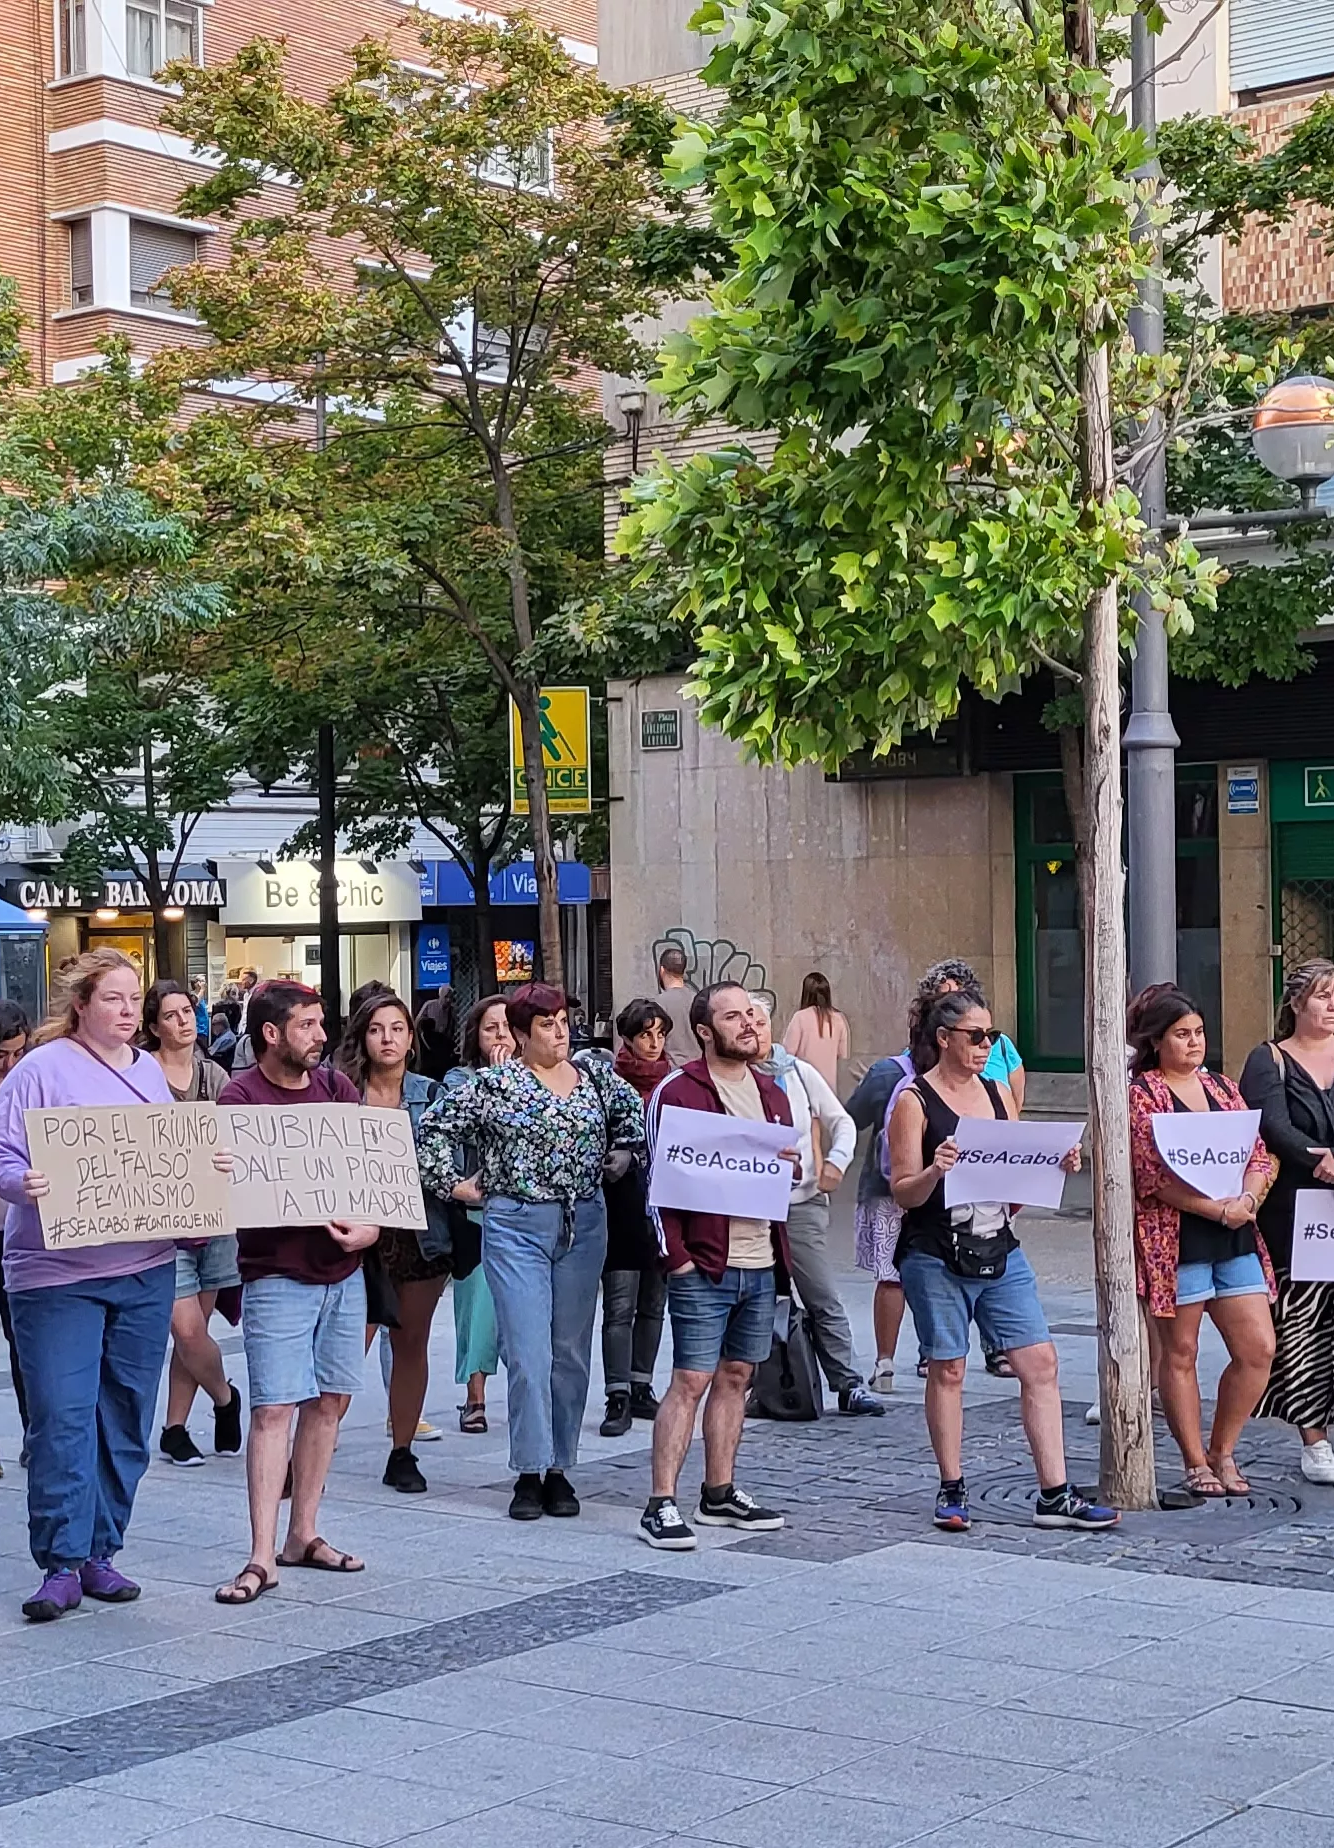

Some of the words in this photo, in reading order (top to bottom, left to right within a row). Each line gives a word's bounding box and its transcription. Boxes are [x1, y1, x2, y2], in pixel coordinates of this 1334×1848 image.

[266, 880, 299, 908] Be
[337, 880, 384, 907] Chic
[512, 874, 539, 898] Via
[421, 960, 448, 974] Viajes
[43, 1117, 105, 1148] POR
[111, 1113, 137, 1144] EL
[76, 1152, 116, 1187] DEL
[232, 1154, 293, 1186] DALE
[303, 1155, 335, 1181] UN
[347, 1155, 419, 1187] PIQUITO
[666, 1144, 781, 1175] #SeAcabó
[956, 1150, 1060, 1166] #SeAcabó
[1167, 1146, 1251, 1166] #SeAcab
[282, 1189, 303, 1218] A
[305, 1189, 337, 1214] TU
[348, 1188, 423, 1222] MADRE
[48, 1212, 130, 1246] #SEACABÓ
